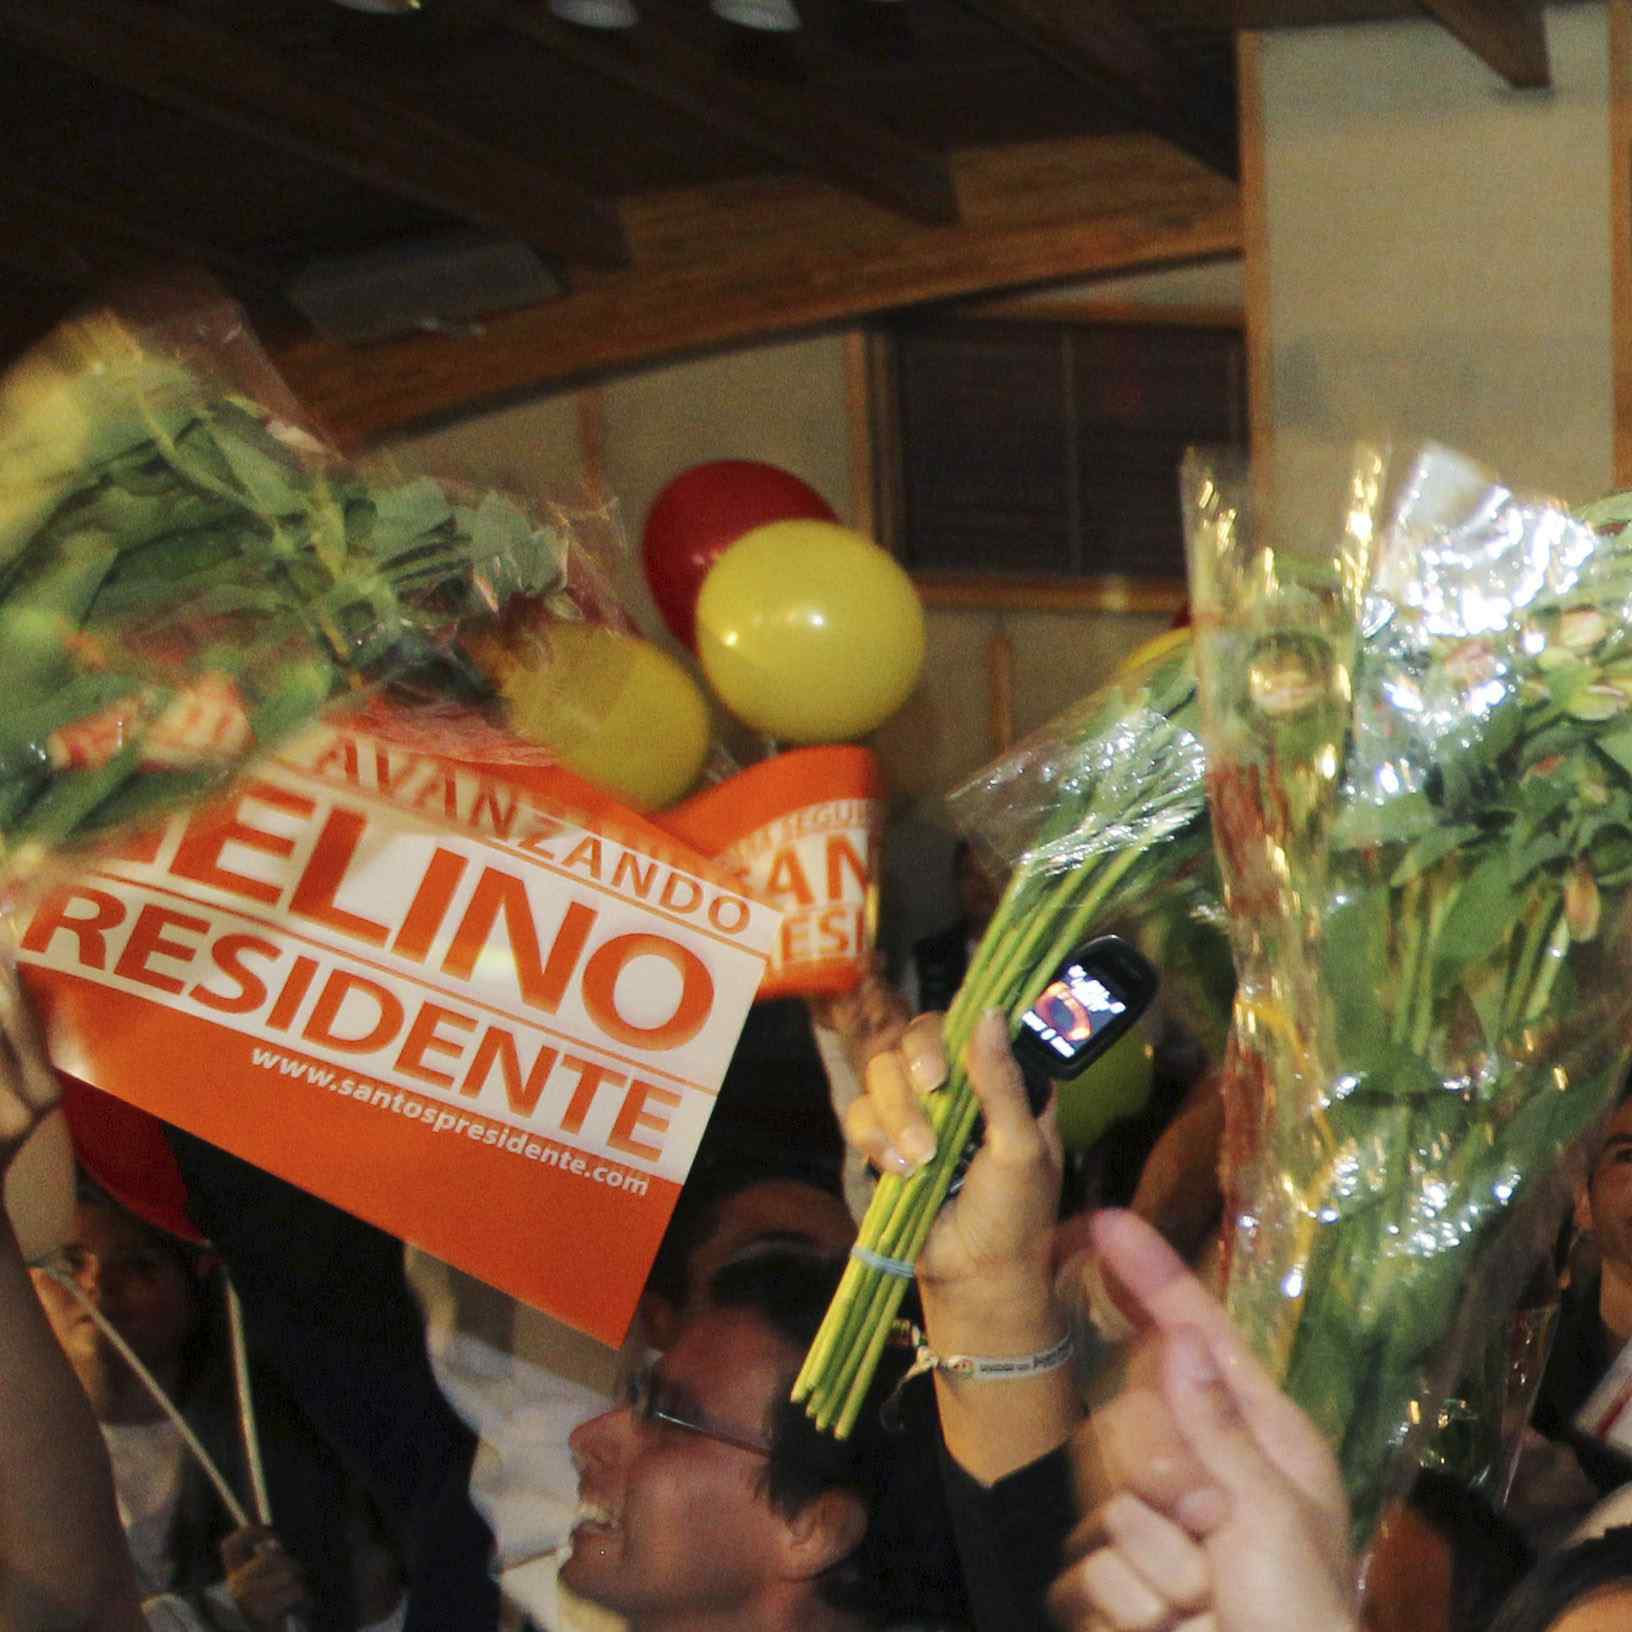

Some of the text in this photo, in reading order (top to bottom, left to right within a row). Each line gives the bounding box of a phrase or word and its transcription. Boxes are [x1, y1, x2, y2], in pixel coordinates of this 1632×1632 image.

[104, 780, 716, 1053] ELINO
[315, 732, 752, 937] AVANZANDO
[20, 884, 683, 1164] RESIDENTE
[251, 1045, 649, 1197] www.santospresidente.com
